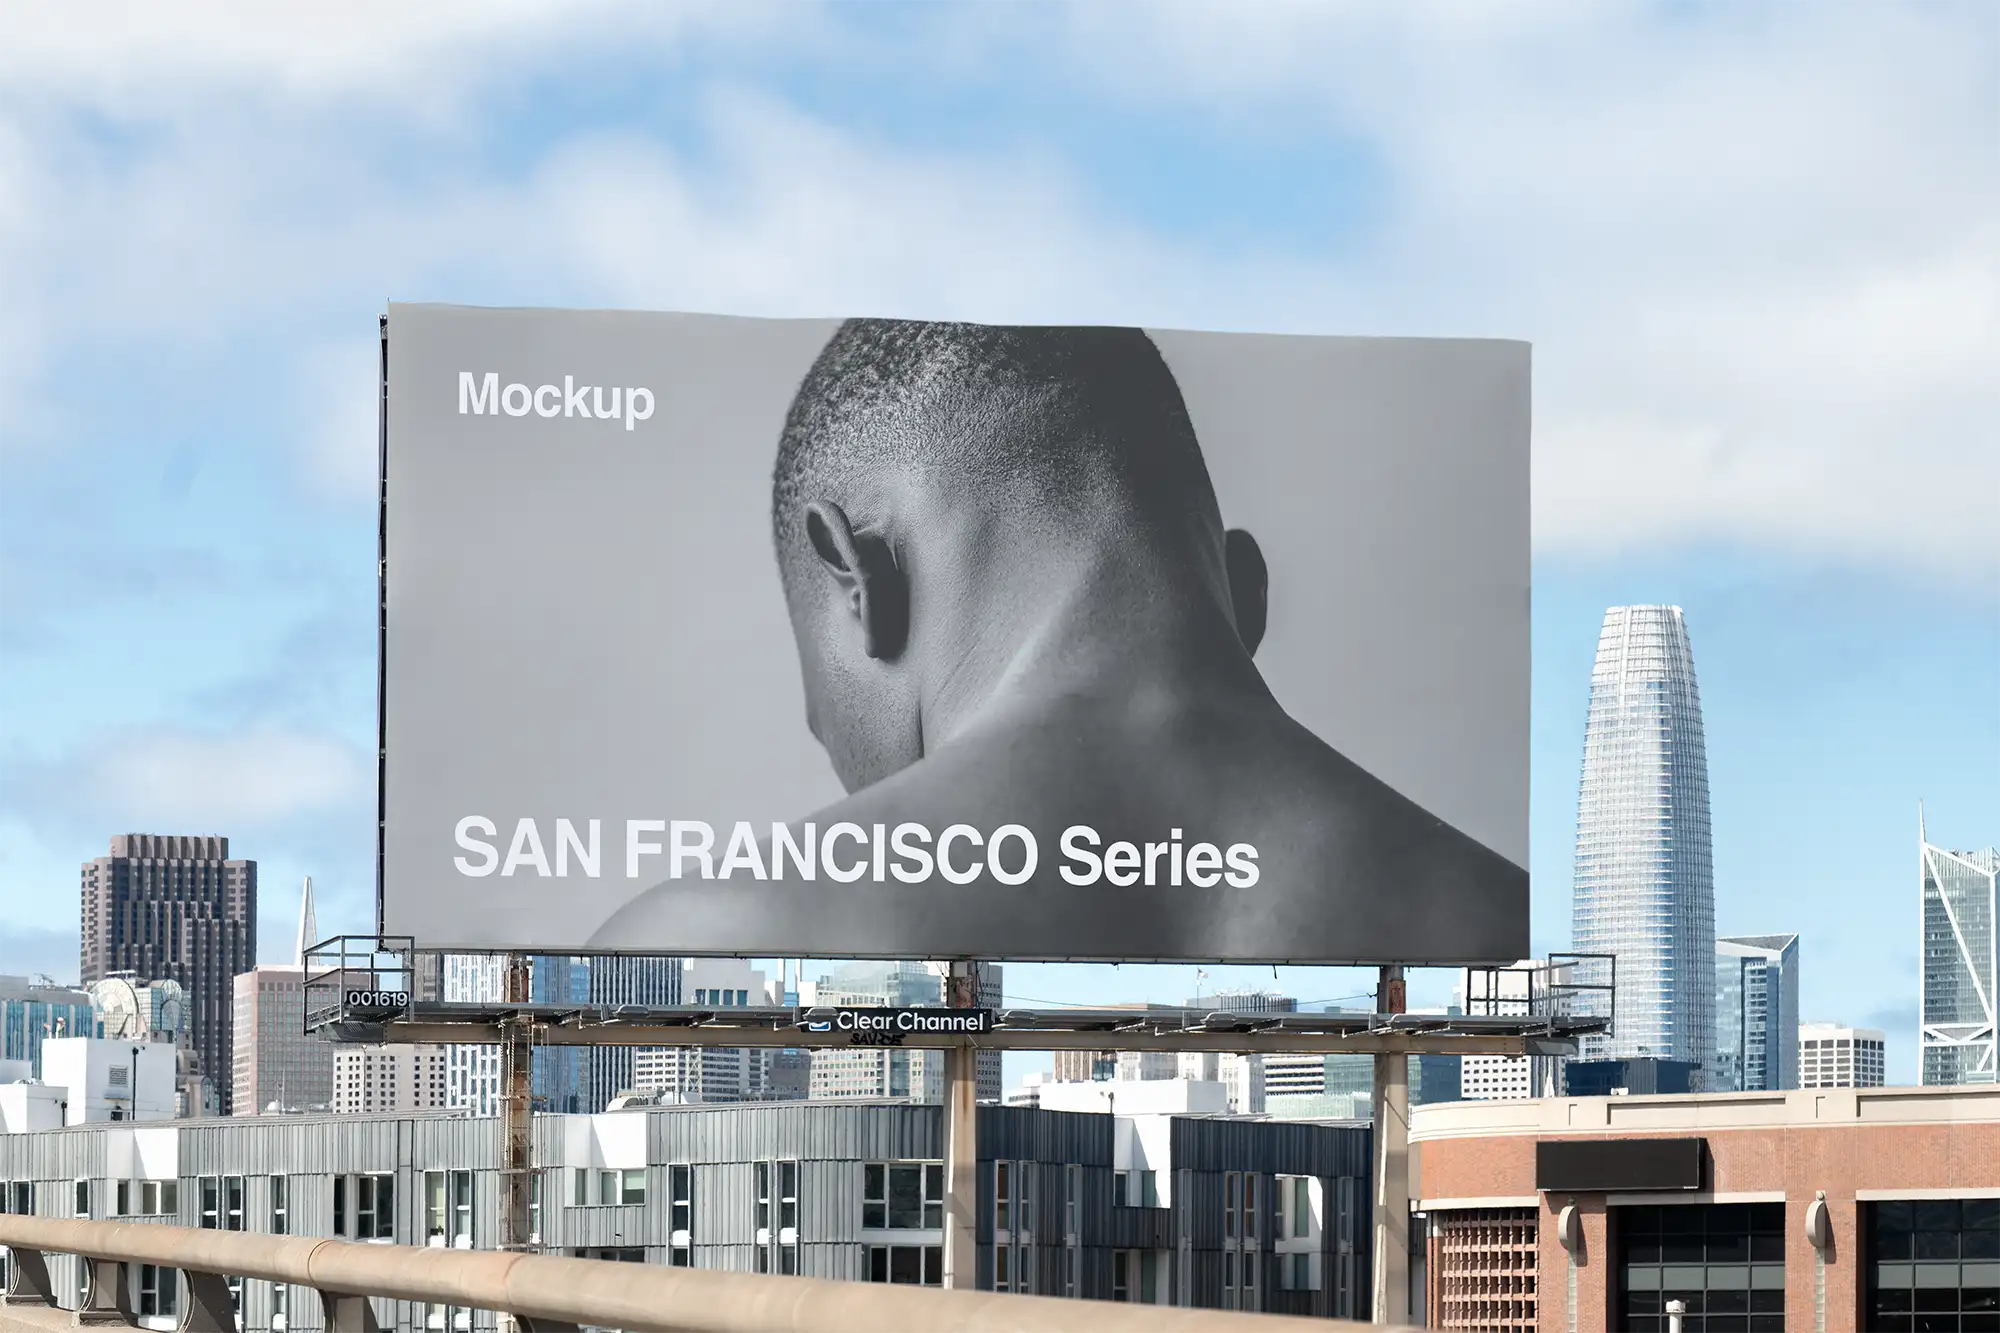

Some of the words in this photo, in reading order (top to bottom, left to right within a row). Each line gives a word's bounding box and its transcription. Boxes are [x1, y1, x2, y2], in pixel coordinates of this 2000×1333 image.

[458, 371, 655, 431] Mockup
[453, 815, 601, 879] SAN
[625, 819, 1038, 885] FRANCISCO
[1059, 825, 1260, 889] Series
[349, 991, 408, 1006] 001619
[836, 1011, 893, 1030] Clear
[897, 1011, 984, 1031] Channel
